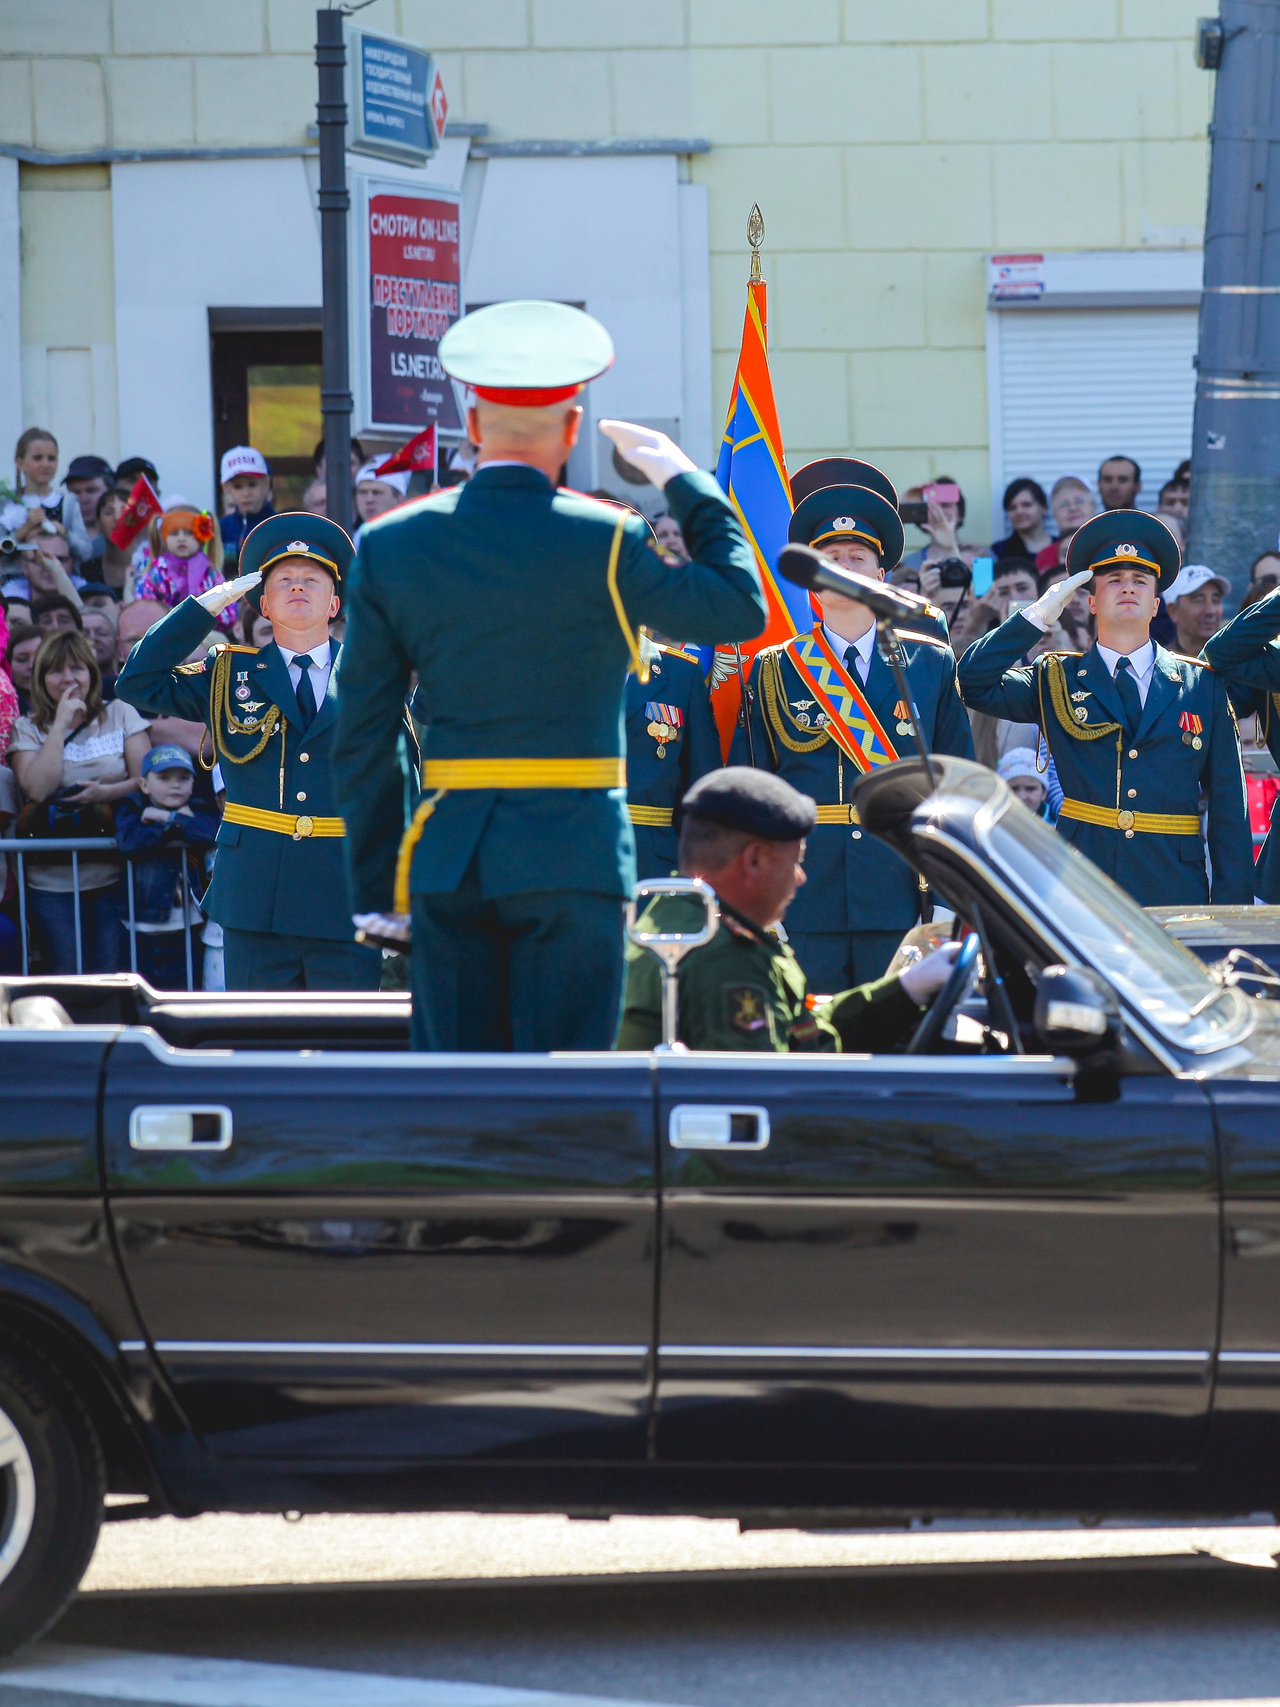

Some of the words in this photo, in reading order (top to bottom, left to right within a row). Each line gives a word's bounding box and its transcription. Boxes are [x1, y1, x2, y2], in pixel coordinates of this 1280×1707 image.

[370, 212, 417, 239] СМОТРИ
[374, 275, 458, 316] ПРЕСТУПЛЕНИЕ
[228, 456, 256, 468] RUSSIA
